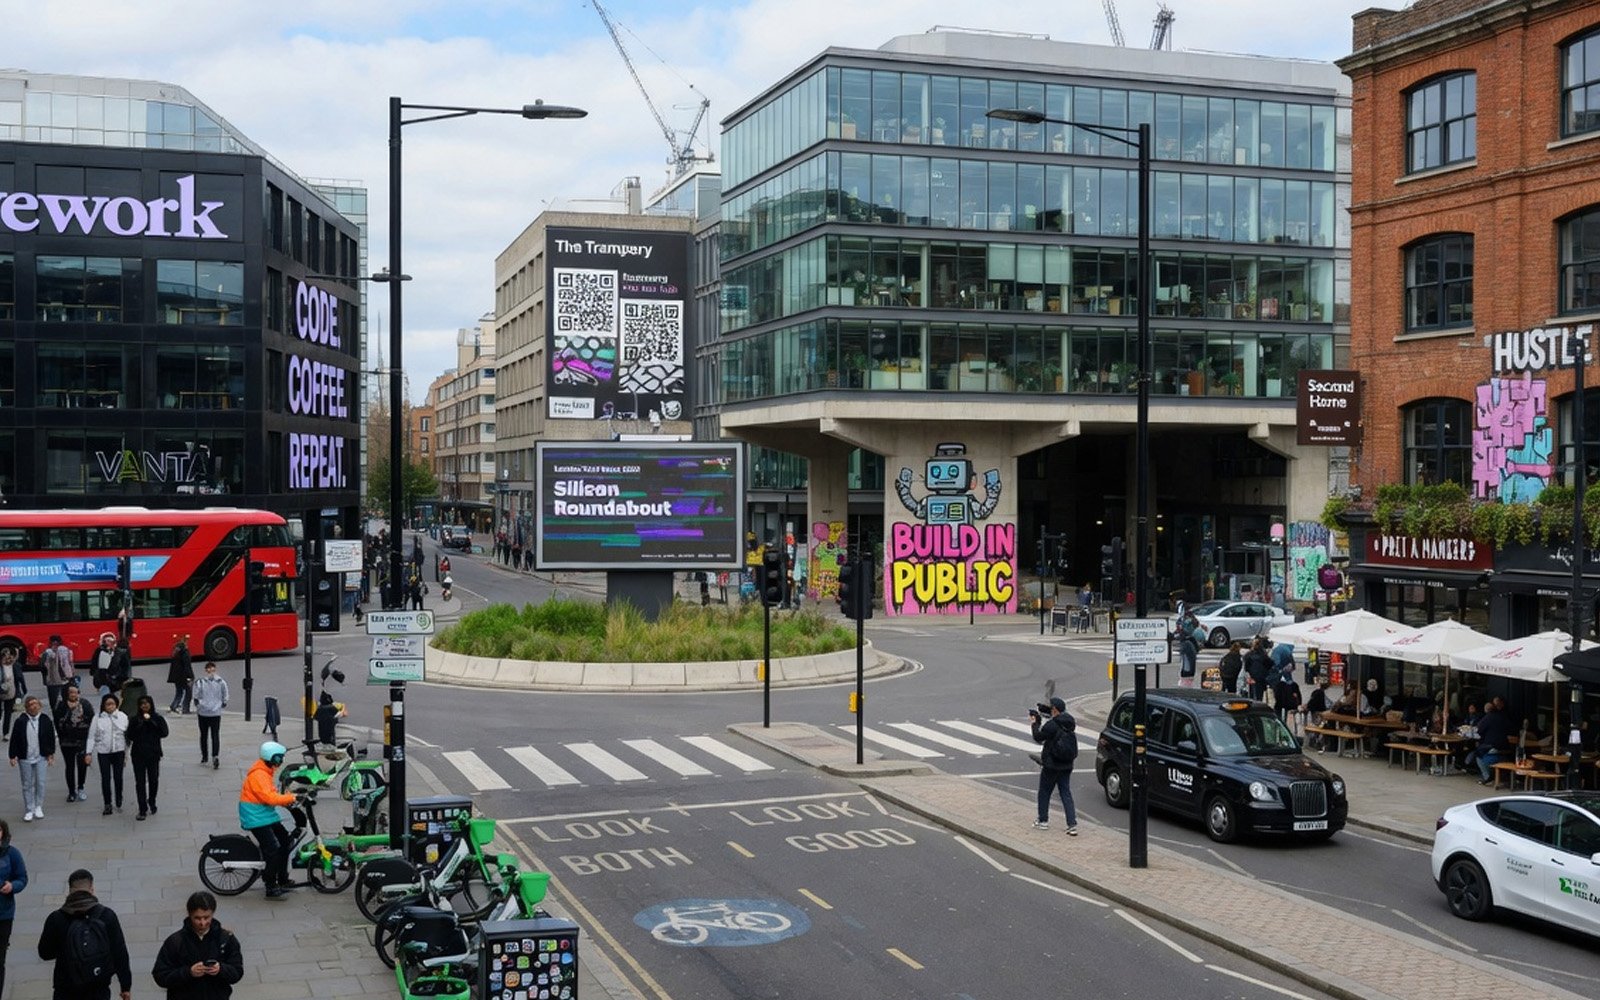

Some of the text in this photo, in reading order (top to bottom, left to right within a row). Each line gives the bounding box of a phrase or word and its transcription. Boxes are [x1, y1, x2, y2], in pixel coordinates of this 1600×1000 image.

[0, 174, 228, 239] ework
[554, 239, 582, 253] The
[295, 281, 341, 348] CODE.
[1494, 324, 1593, 371] HUSTLE
[288, 354, 348, 418] COFFEE.
[289, 432, 347, 489] REPEAT.
[554, 479, 620, 497] Silicon
[554, 498, 672, 516] Roundabout
[892, 522, 1015, 560] BUILD IN
[892, 561, 1013, 606] PUBLIC
[531, 815, 670, 843] LOOK
[729, 800, 869, 827] LOOK
[785, 828, 917, 854] GOOD
[559, 845, 694, 876] BOTH
